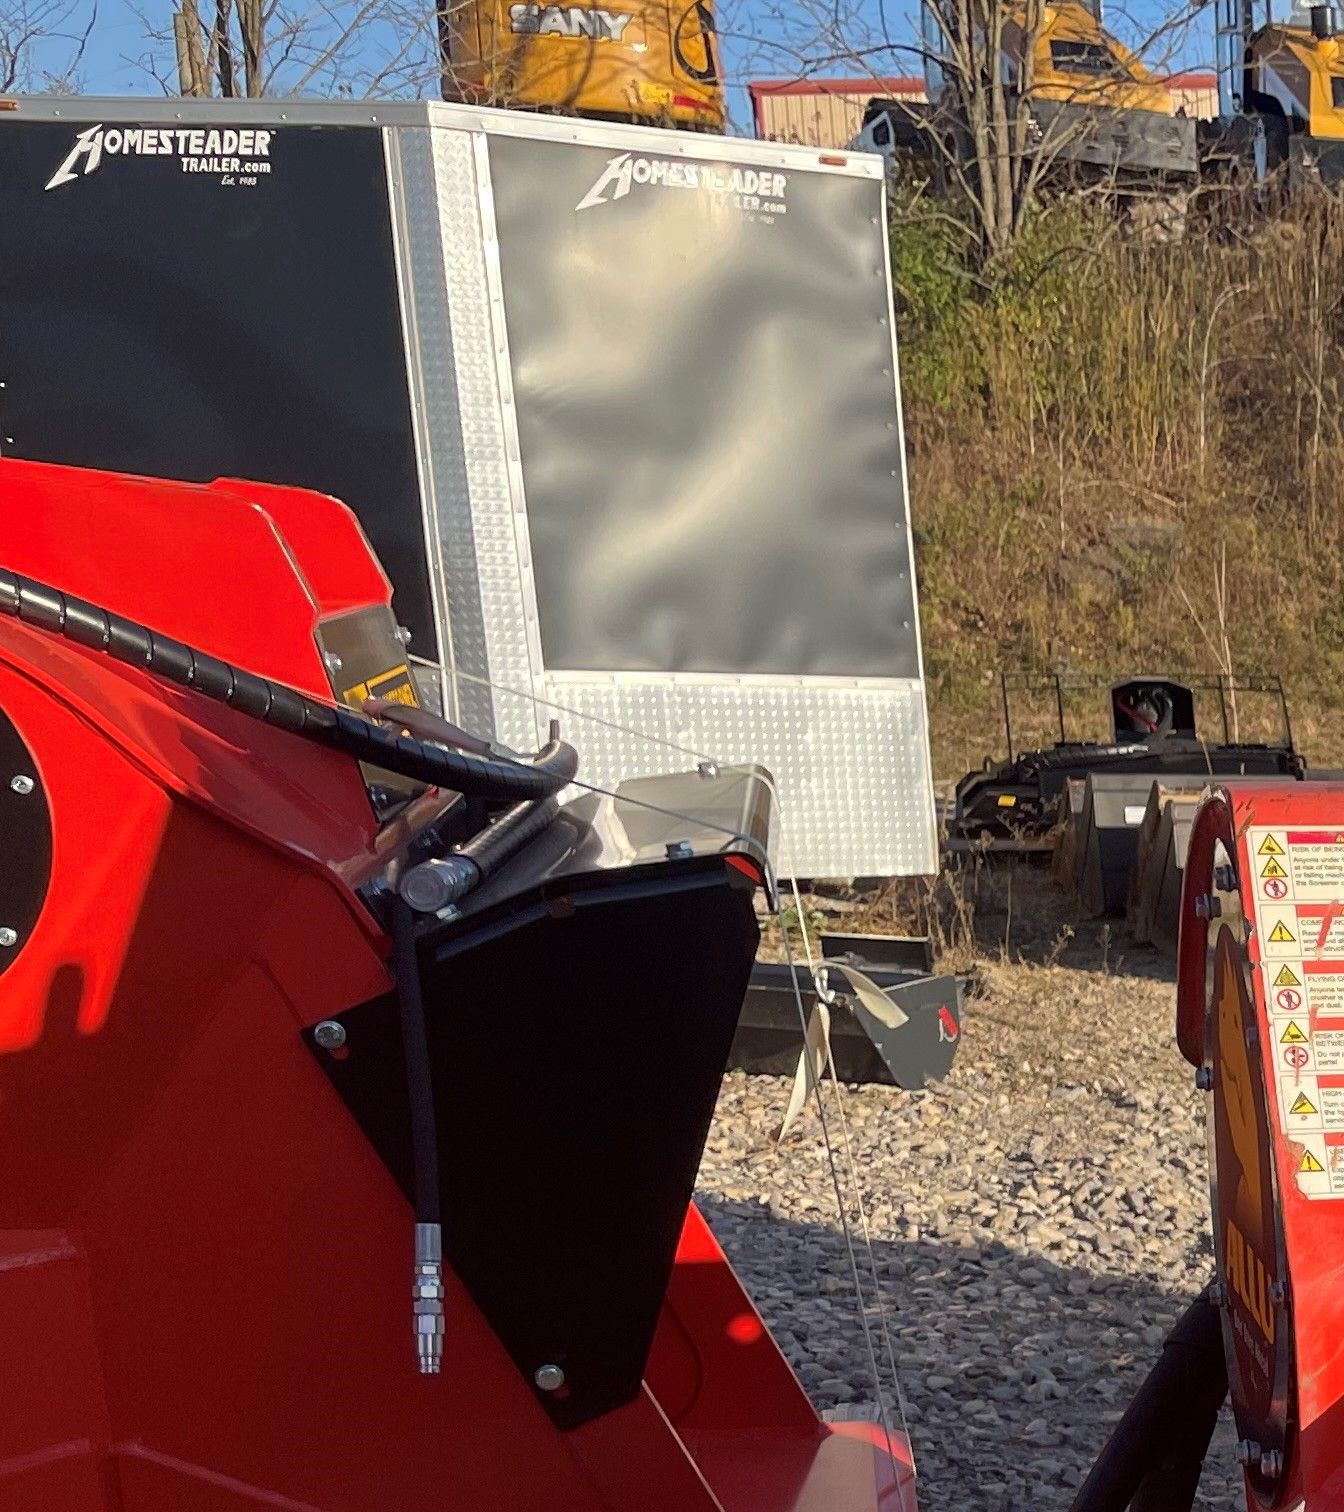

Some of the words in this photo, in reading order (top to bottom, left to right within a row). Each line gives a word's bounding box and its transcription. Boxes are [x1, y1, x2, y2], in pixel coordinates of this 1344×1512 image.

[511, 4, 633, 40] SANY
[181, 157, 270, 173] TRAILER.com
[1227, 1219, 1274, 1345] ALLU
